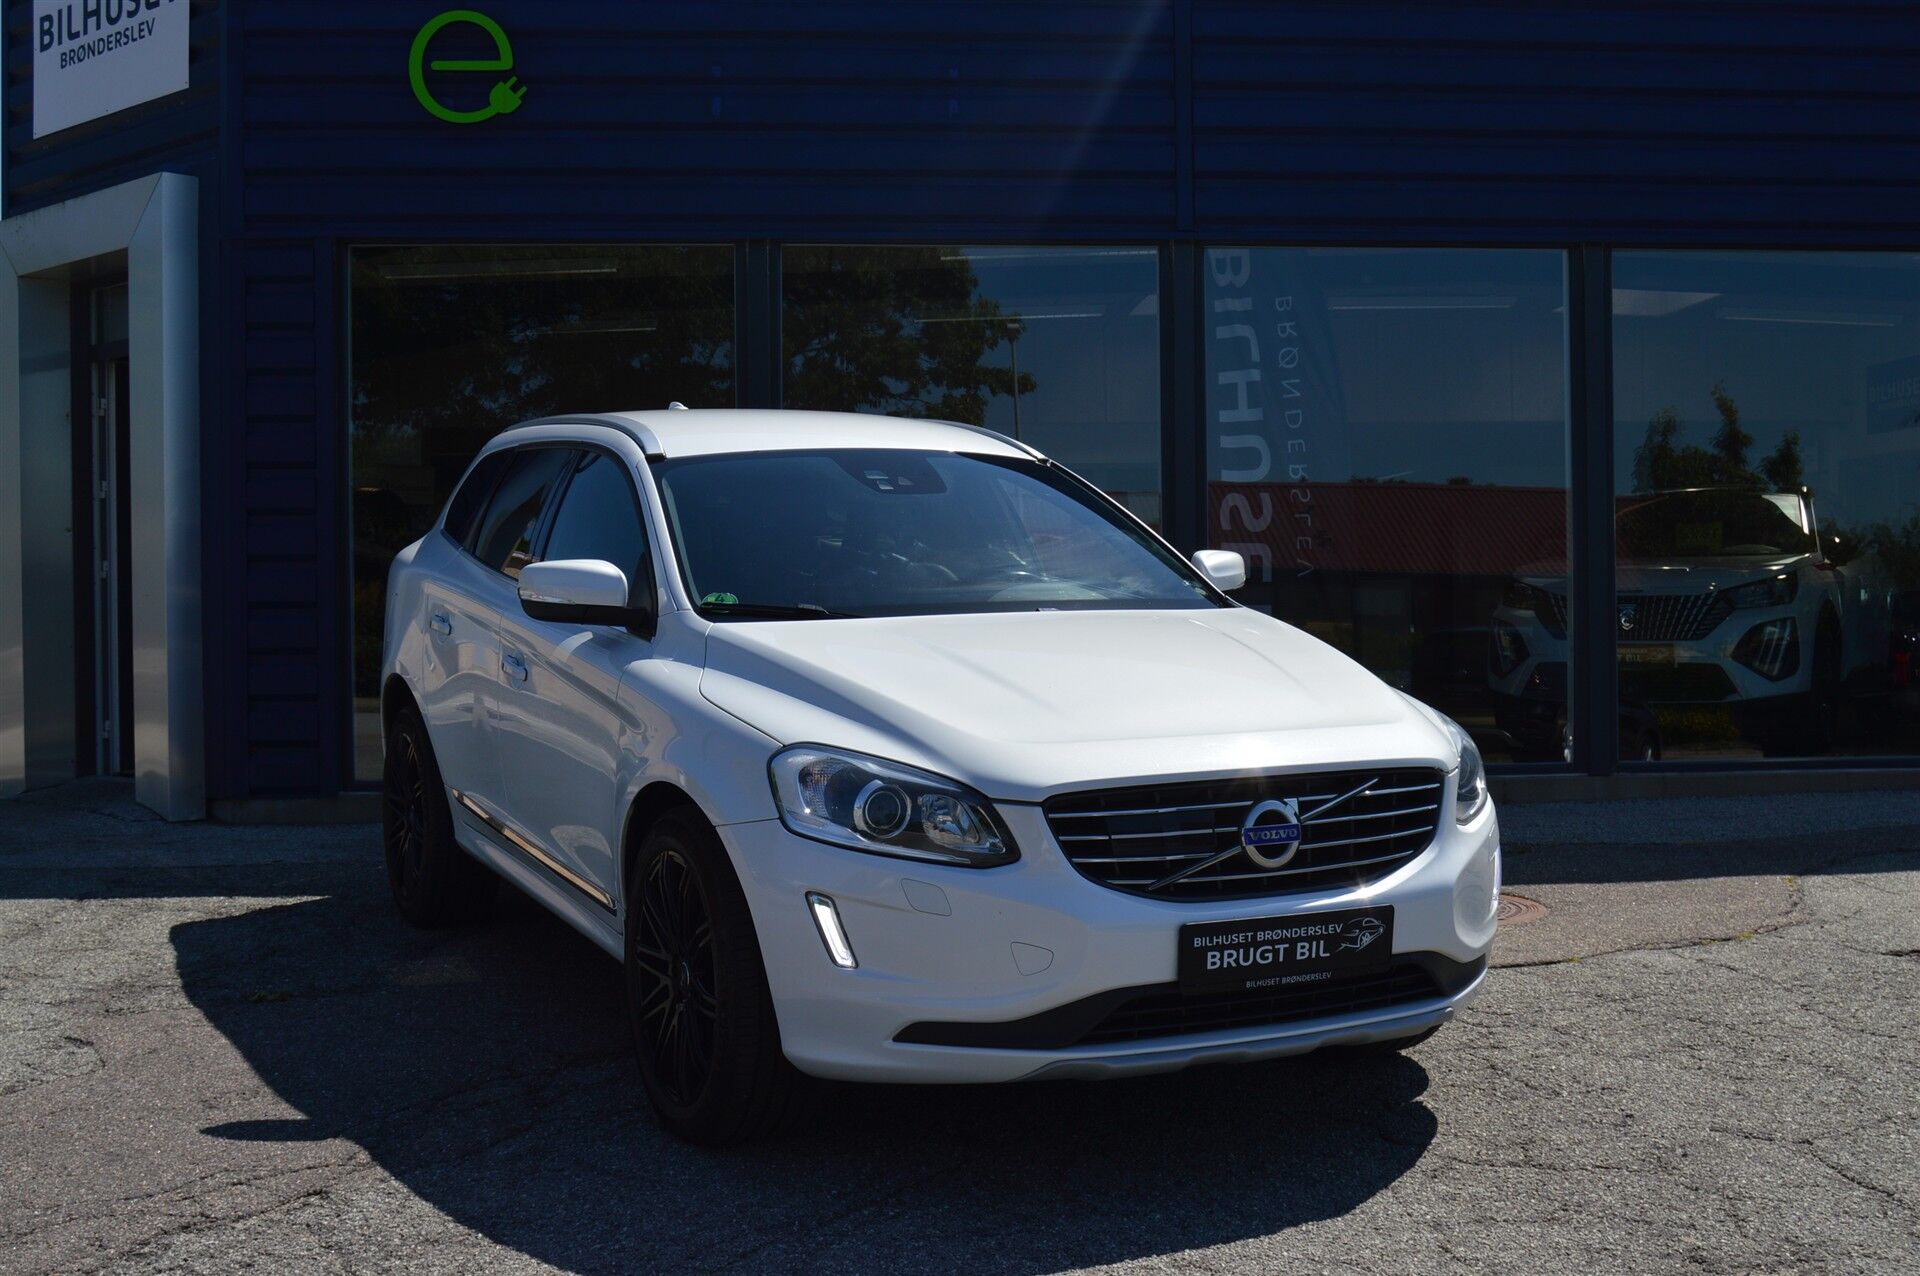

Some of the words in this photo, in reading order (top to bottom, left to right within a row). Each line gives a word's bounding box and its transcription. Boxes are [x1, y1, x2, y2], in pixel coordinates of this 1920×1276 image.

[39, 0, 175, 53] BILHU
[60, 17, 156, 69] BRØNDERSLEV
[1249, 829, 1297, 840] VOLVO
[1193, 932, 1254, 948] BILHUSET
[1257, 923, 1343, 942] BRØNDERSLEV
[1206, 944, 1289, 970] BRUGT
[1296, 940, 1331, 961] BIL
[1246, 977, 1279, 988] BILHUSET
[1281, 972, 1332, 985] BRØNDERSLEV
